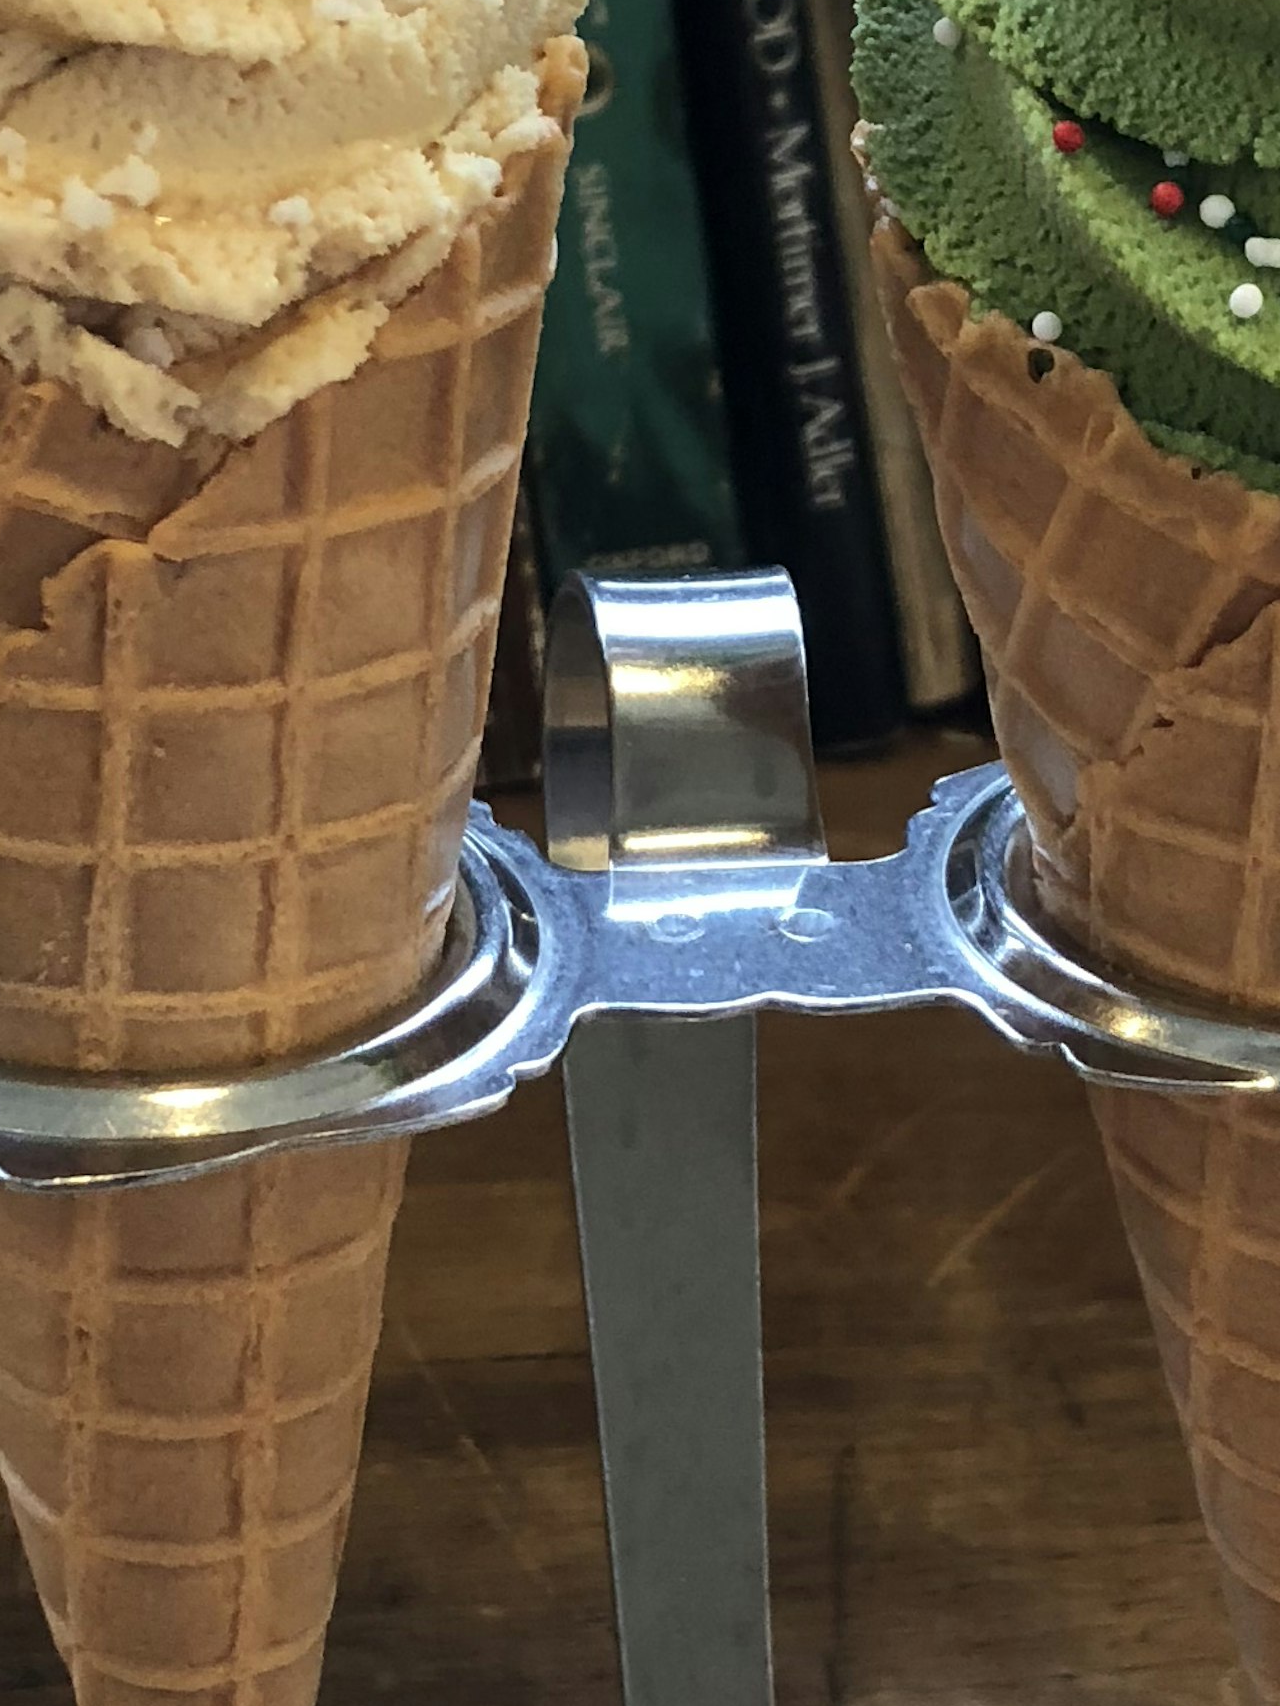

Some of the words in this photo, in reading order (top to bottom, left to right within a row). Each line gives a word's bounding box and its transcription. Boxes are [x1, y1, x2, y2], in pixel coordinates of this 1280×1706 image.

[576, 163, 630, 355] SINCLAIR
[765, 122, 820, 340] Mortimer
[798, 390, 855, 507] Adler
